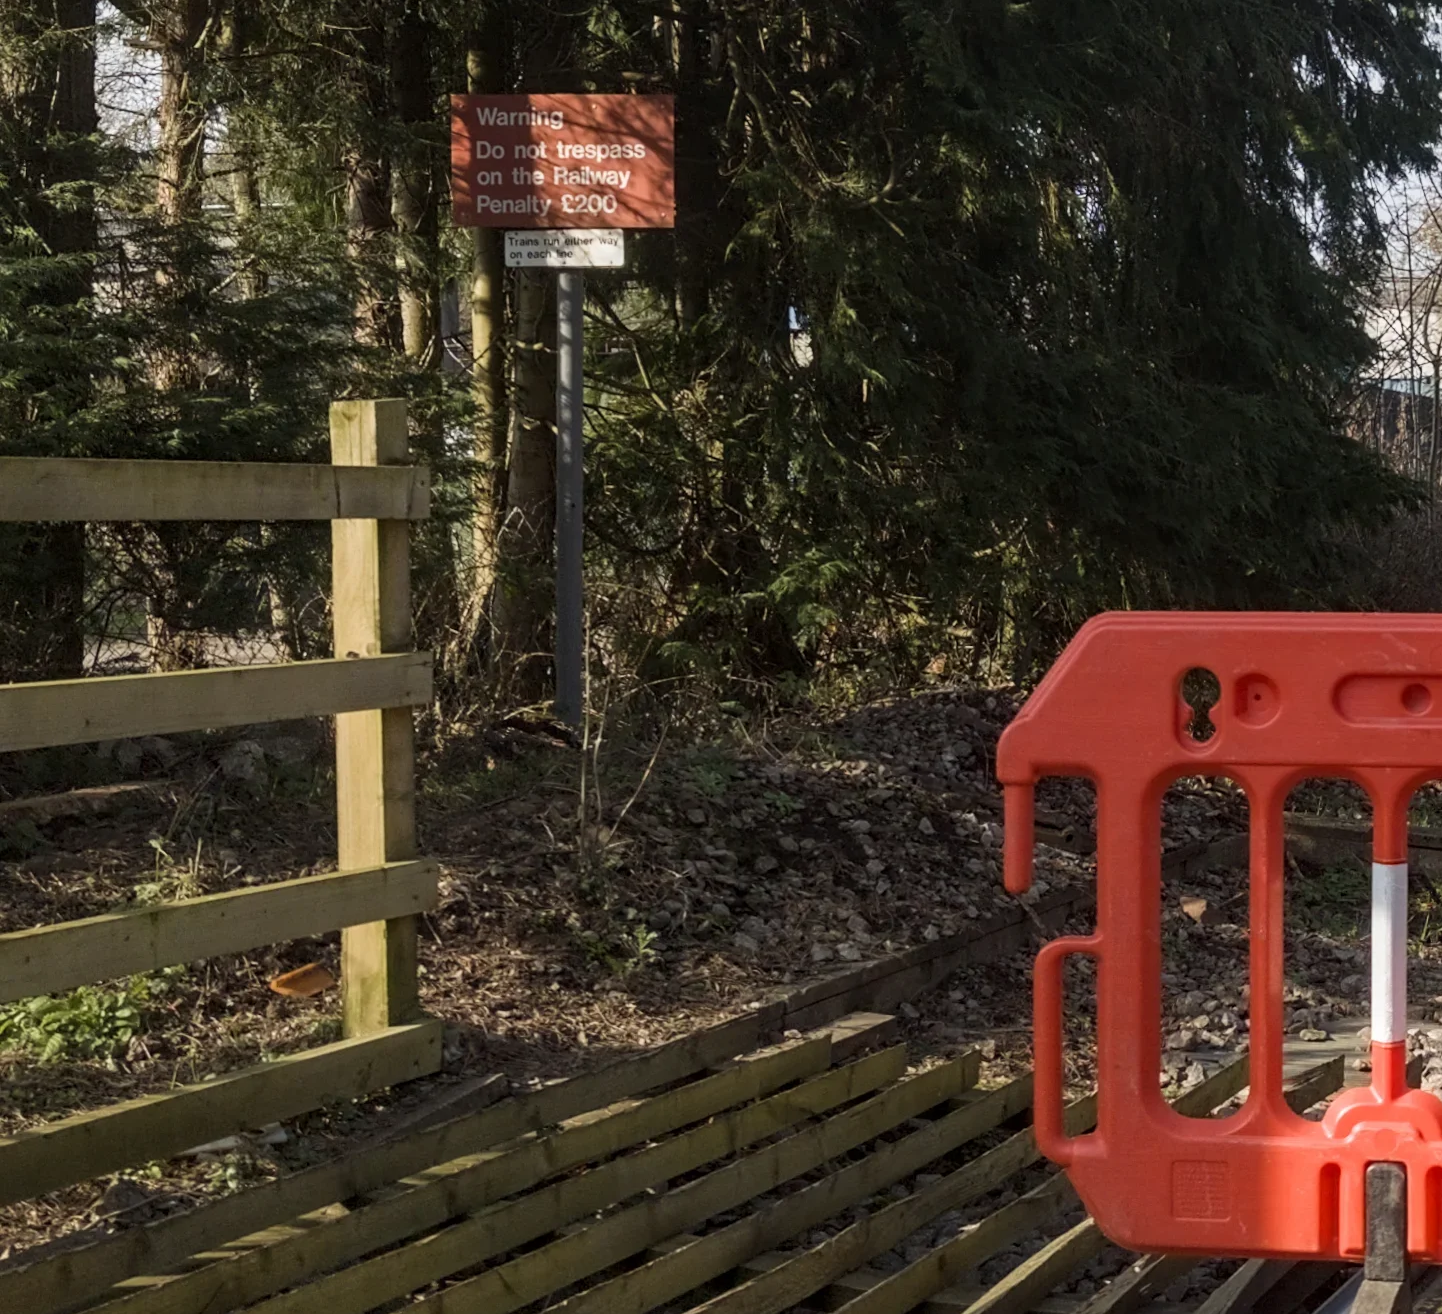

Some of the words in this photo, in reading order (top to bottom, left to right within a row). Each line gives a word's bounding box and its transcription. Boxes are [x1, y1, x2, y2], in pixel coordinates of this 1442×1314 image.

[476, 107, 564, 129] Warning
[476, 141, 505, 159] Do
[515, 141, 547, 159] not
[556, 141, 646, 162] trespass
[477, 170, 502, 185] on
[512, 167, 545, 185] the
[553, 166, 631, 188] Railway
[476, 194, 552, 216] Penalty
[561, 193, 618, 214] £200
[508, 237, 539, 246] Trains
[543, 238, 560, 246] run
[564, 237, 593, 246] either
[599, 237, 619, 246] way
[509, 251, 523, 259] on
[527, 250, 552, 259] each
[556, 249, 573, 258] line
